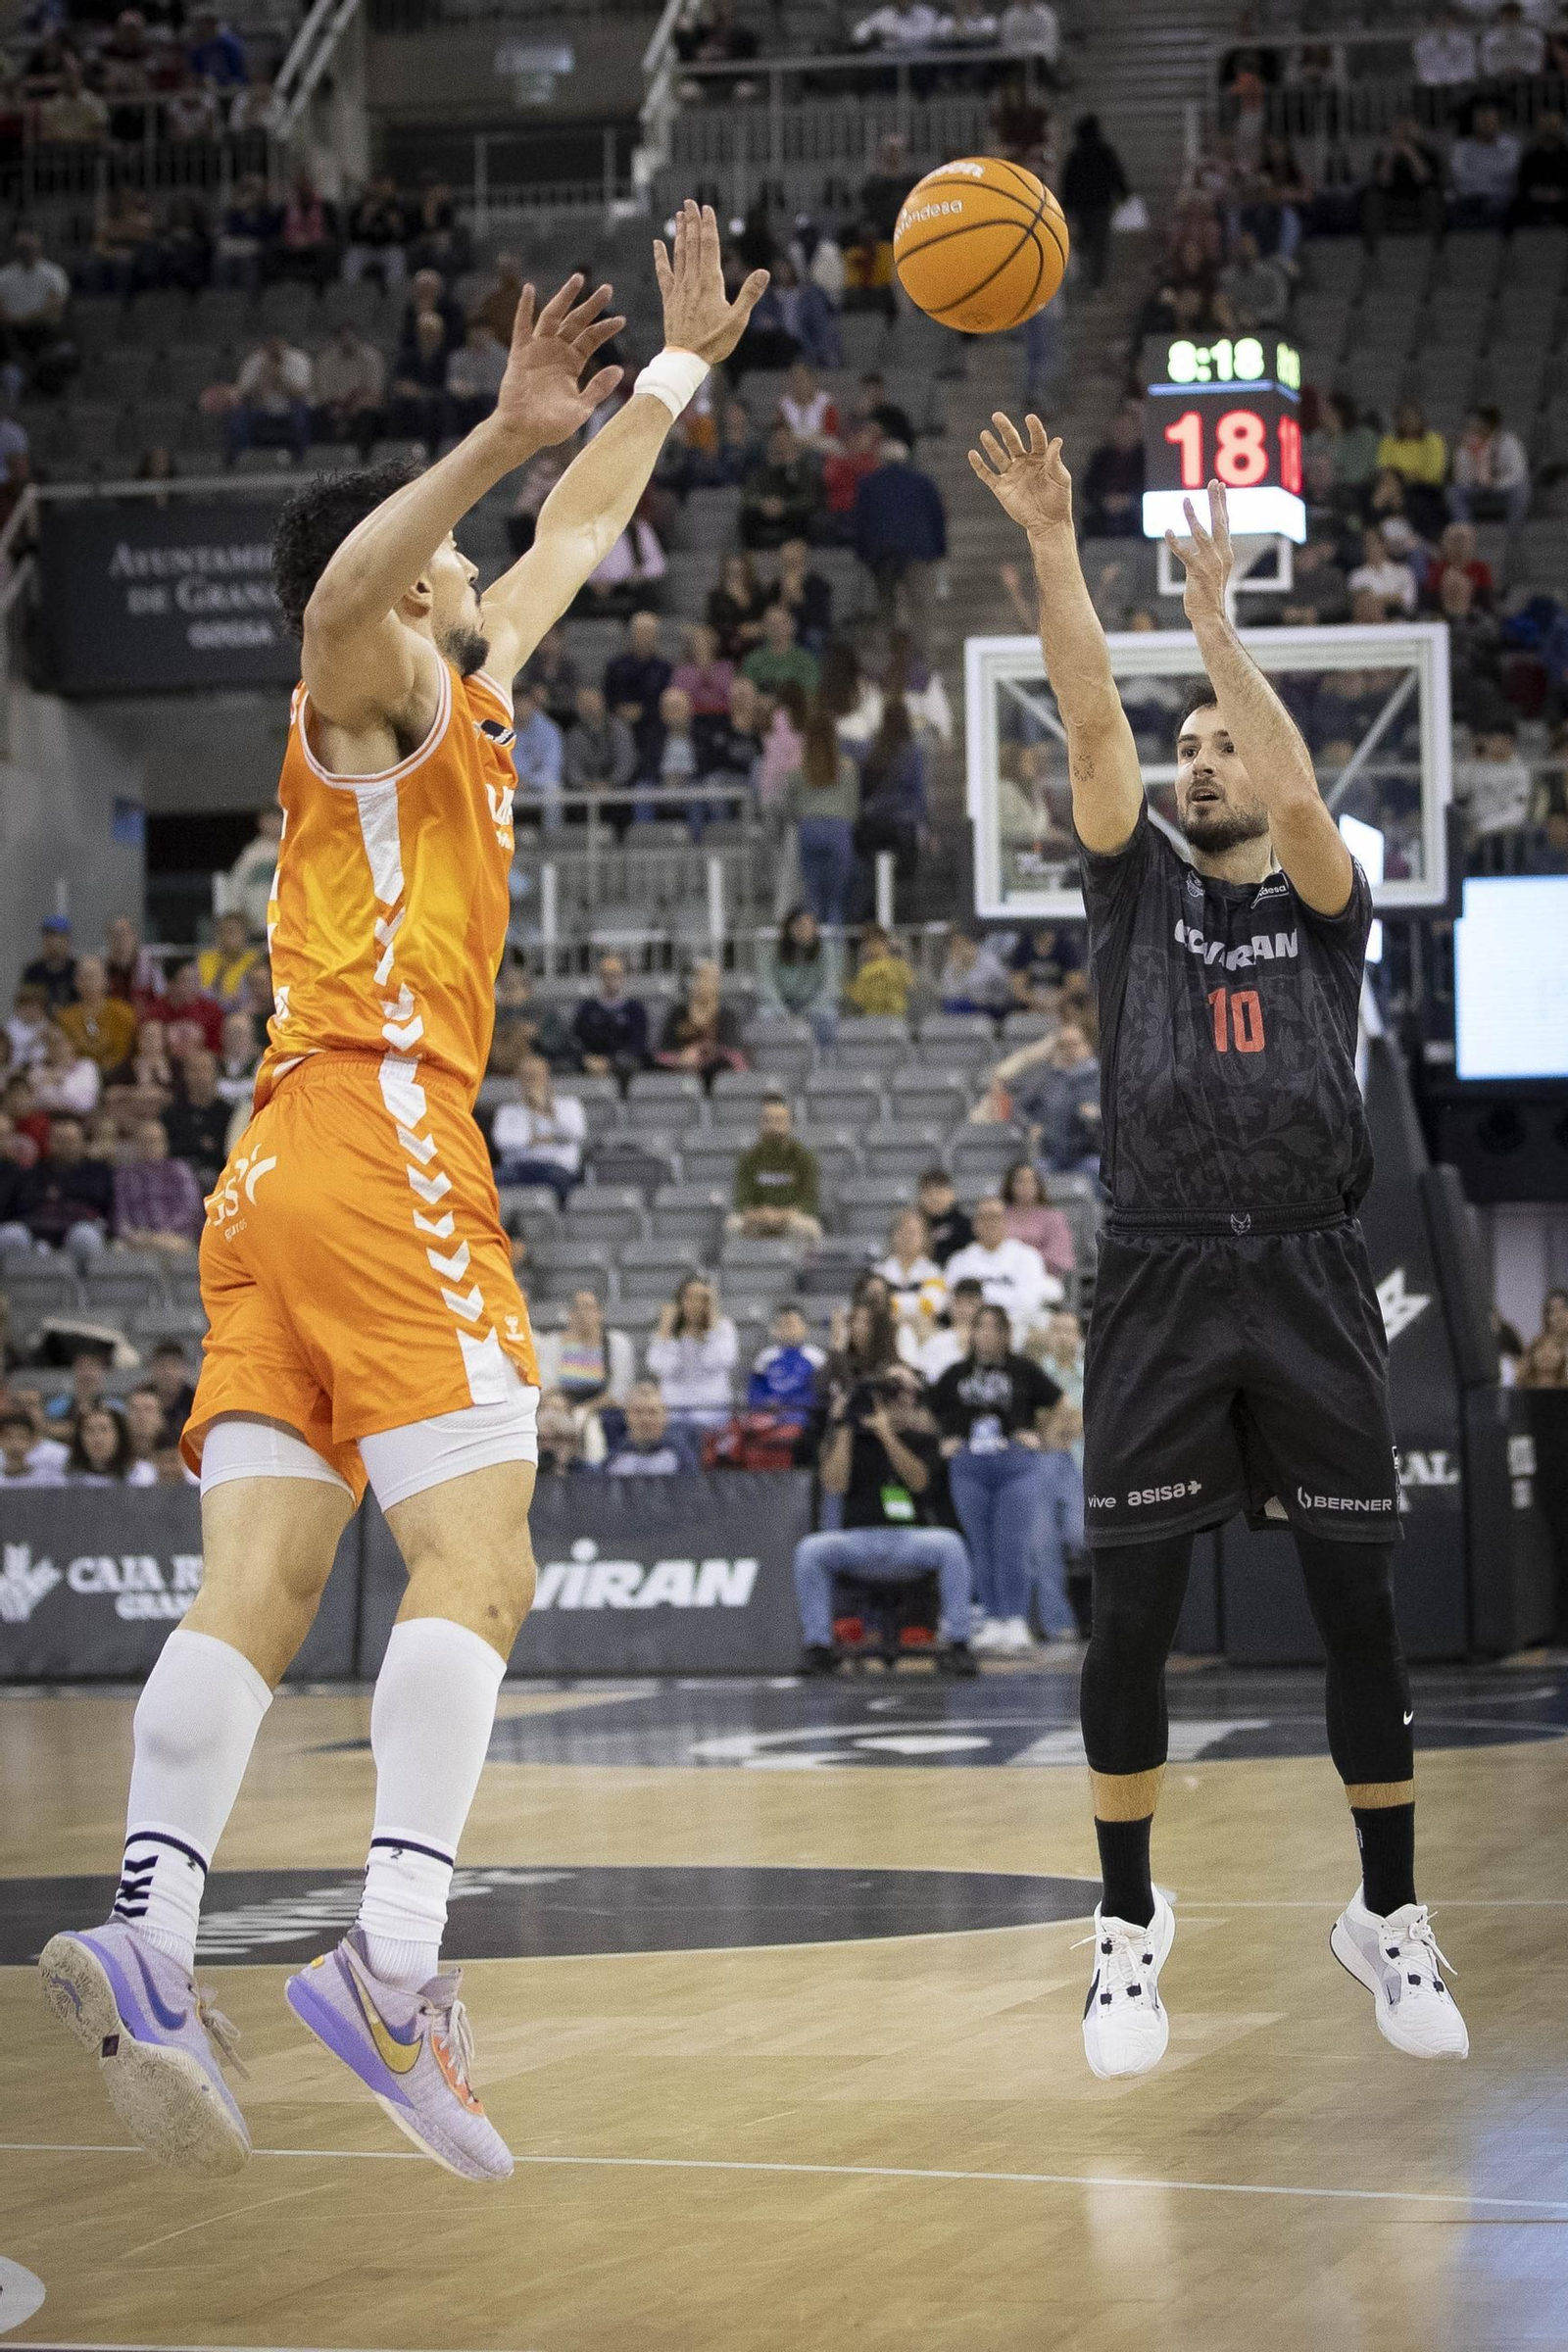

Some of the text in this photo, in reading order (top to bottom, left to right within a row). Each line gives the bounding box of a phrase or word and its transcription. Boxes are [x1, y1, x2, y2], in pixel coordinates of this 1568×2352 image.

[1168, 338, 1264, 383] 8:18
[1164, 409, 1269, 488] 18
[1207, 987, 1265, 1053] 10
[1314, 1495, 1393, 1512] BERNER
